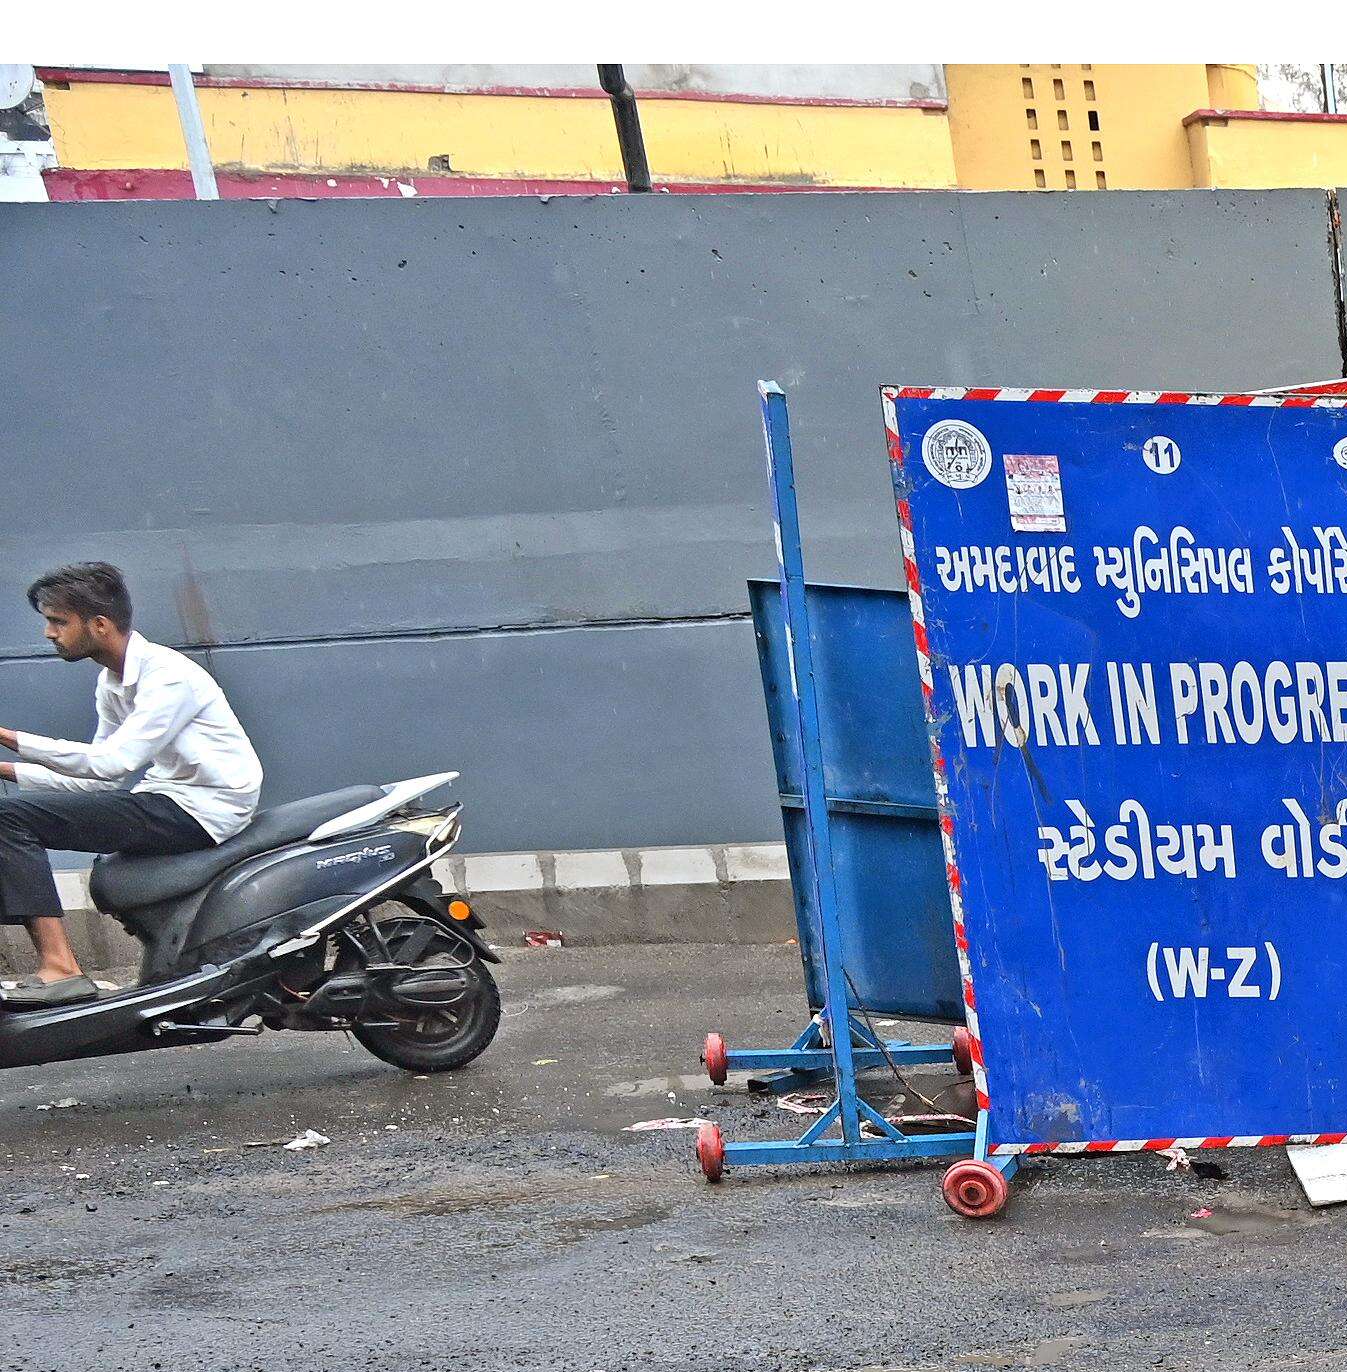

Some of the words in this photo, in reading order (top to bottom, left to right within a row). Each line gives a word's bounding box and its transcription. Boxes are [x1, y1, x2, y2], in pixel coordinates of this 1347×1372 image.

[1150, 442, 1175, 467] 11
[935, 545, 1082, 594] અમદાવાદ
[1093, 525, 1255, 618] મ્યુનિસિપલ
[949, 662, 1100, 748] WORK
[1106, 661, 1160, 746] IN
[1038, 799, 1236, 881] સ્ટેડીયમ
[1146, 941, 1282, 1001] (W-Z)
